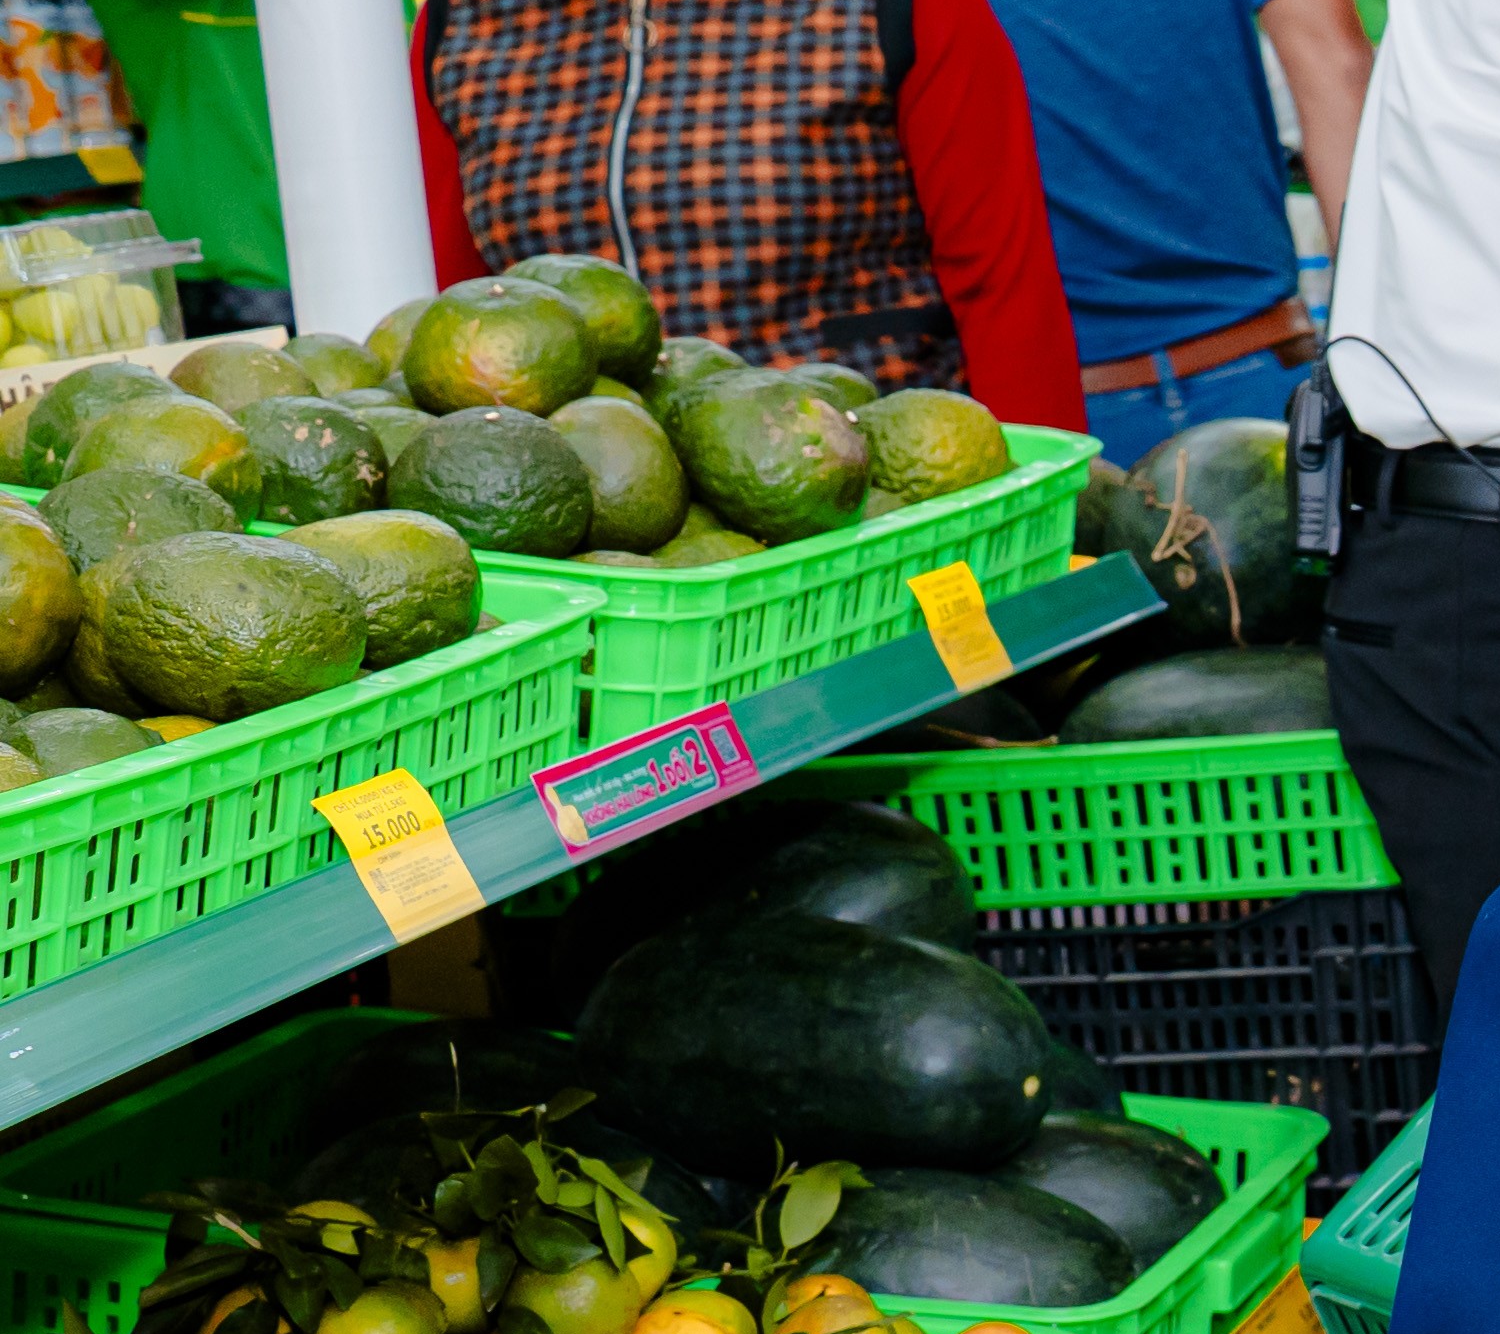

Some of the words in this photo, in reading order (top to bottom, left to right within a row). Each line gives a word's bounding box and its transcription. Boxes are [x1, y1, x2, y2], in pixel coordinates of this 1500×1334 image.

[648, 758, 669, 795] 1
[682, 737, 708, 776] 2
[362, 810, 421, 849] 15.000
